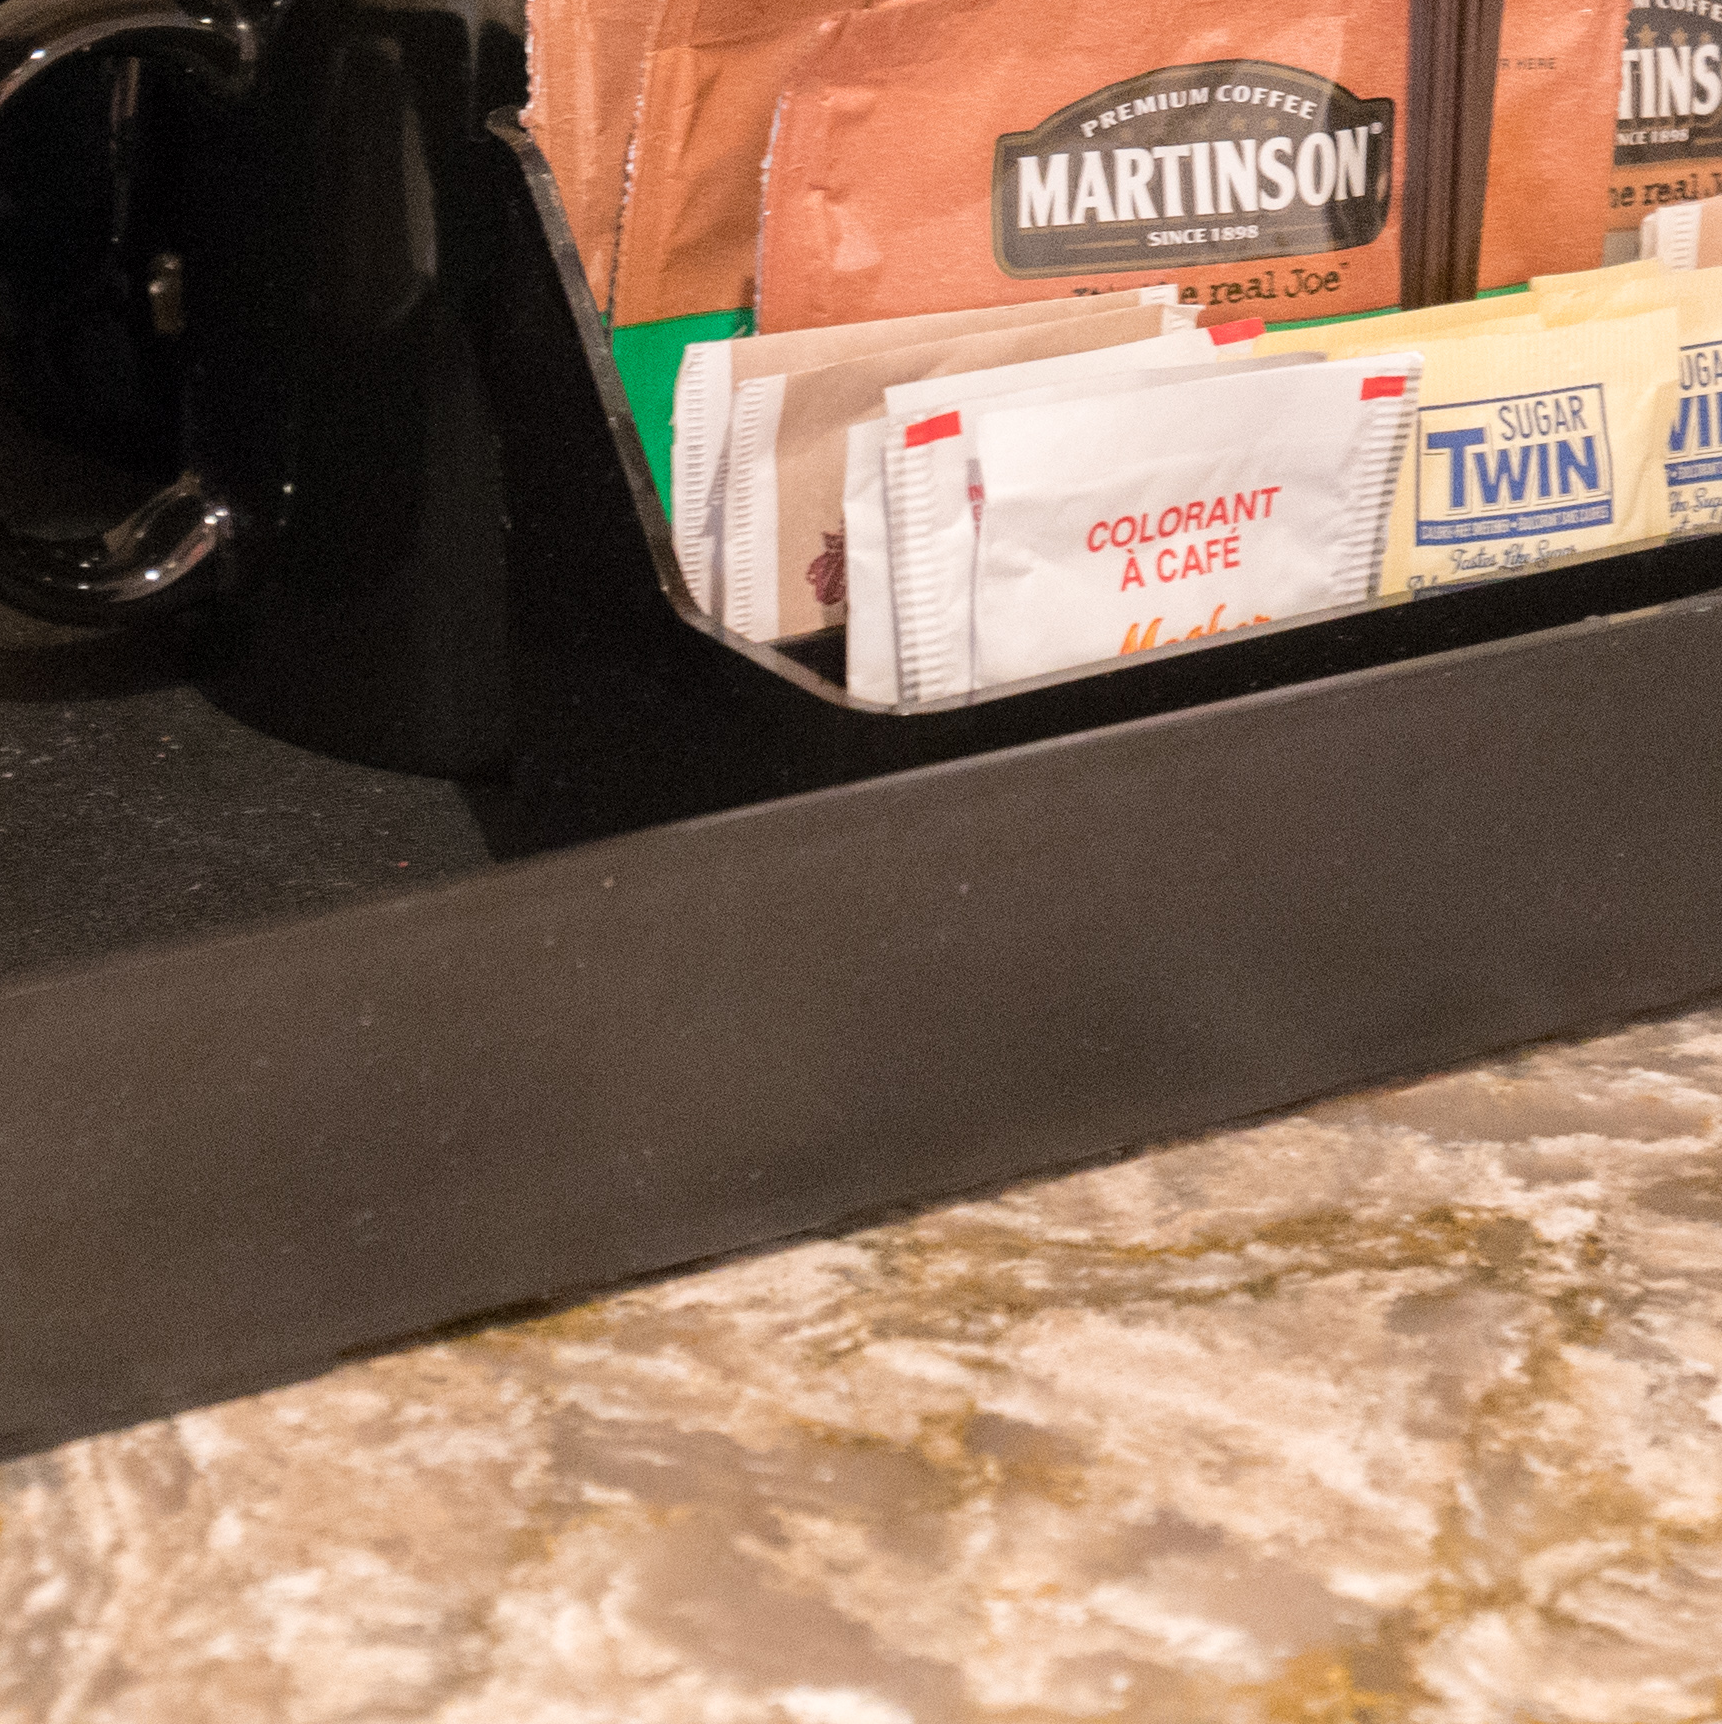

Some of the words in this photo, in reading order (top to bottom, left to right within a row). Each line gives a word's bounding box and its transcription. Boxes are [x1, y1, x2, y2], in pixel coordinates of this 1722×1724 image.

[1080, 86, 1210, 138] PREMIUM
[1214, 84, 1319, 120] COFFEE
[1016, 126, 1370, 229] MARTINSON
[1147, 228, 1207, 247] SINCE
[1211, 224, 1260, 243] 1898
[1209, 271, 1277, 305] real
[1499, 395, 1588, 441] SUGAR
[1426, 427, 1601, 511] TWIN
[1086, 486, 1283, 553] COLORANT
[1120, 547, 1147, 592] À
[1156, 526, 1242, 583] CAFÉ
